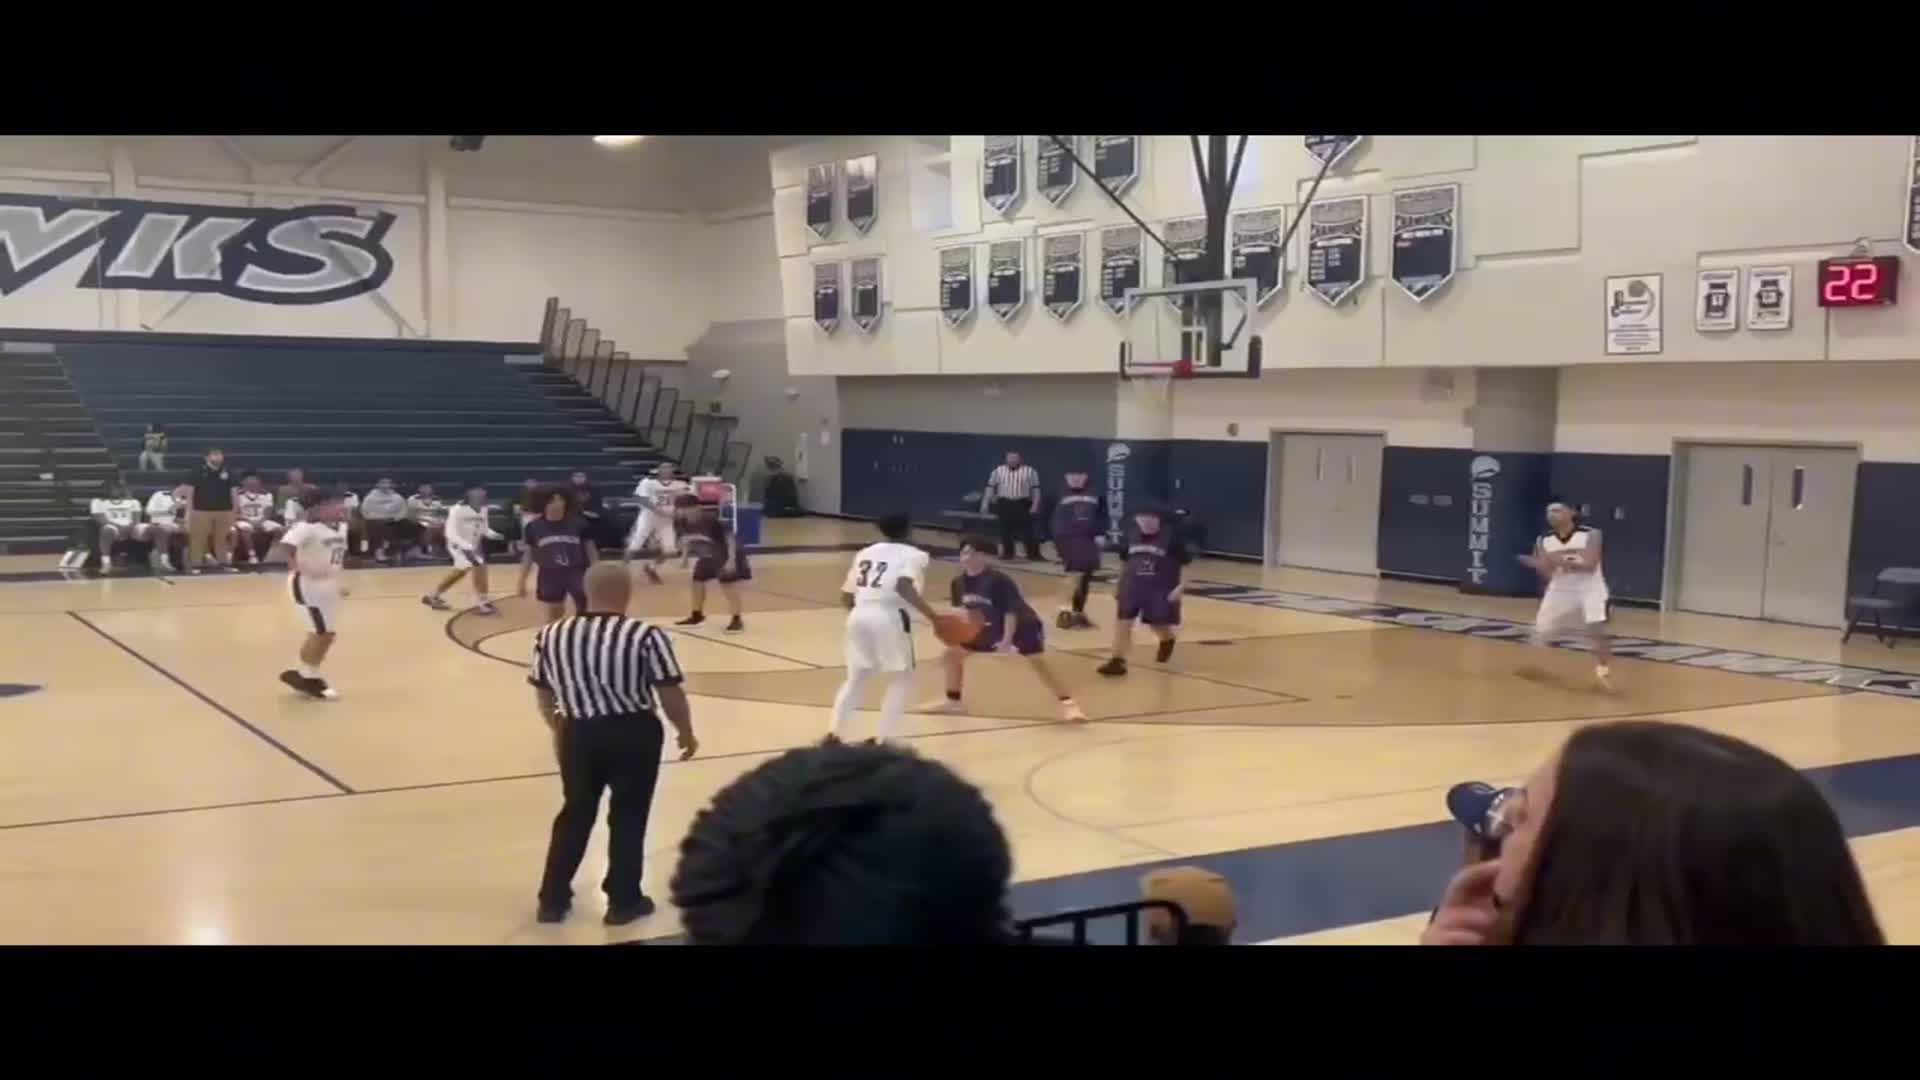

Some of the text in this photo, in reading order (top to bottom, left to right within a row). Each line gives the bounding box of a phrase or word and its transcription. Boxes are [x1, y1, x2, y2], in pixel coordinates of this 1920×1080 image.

[1824, 264, 1878, 301] 22
[1467, 482, 1493, 584] SUMMIT
[856, 560, 888, 588] 32
